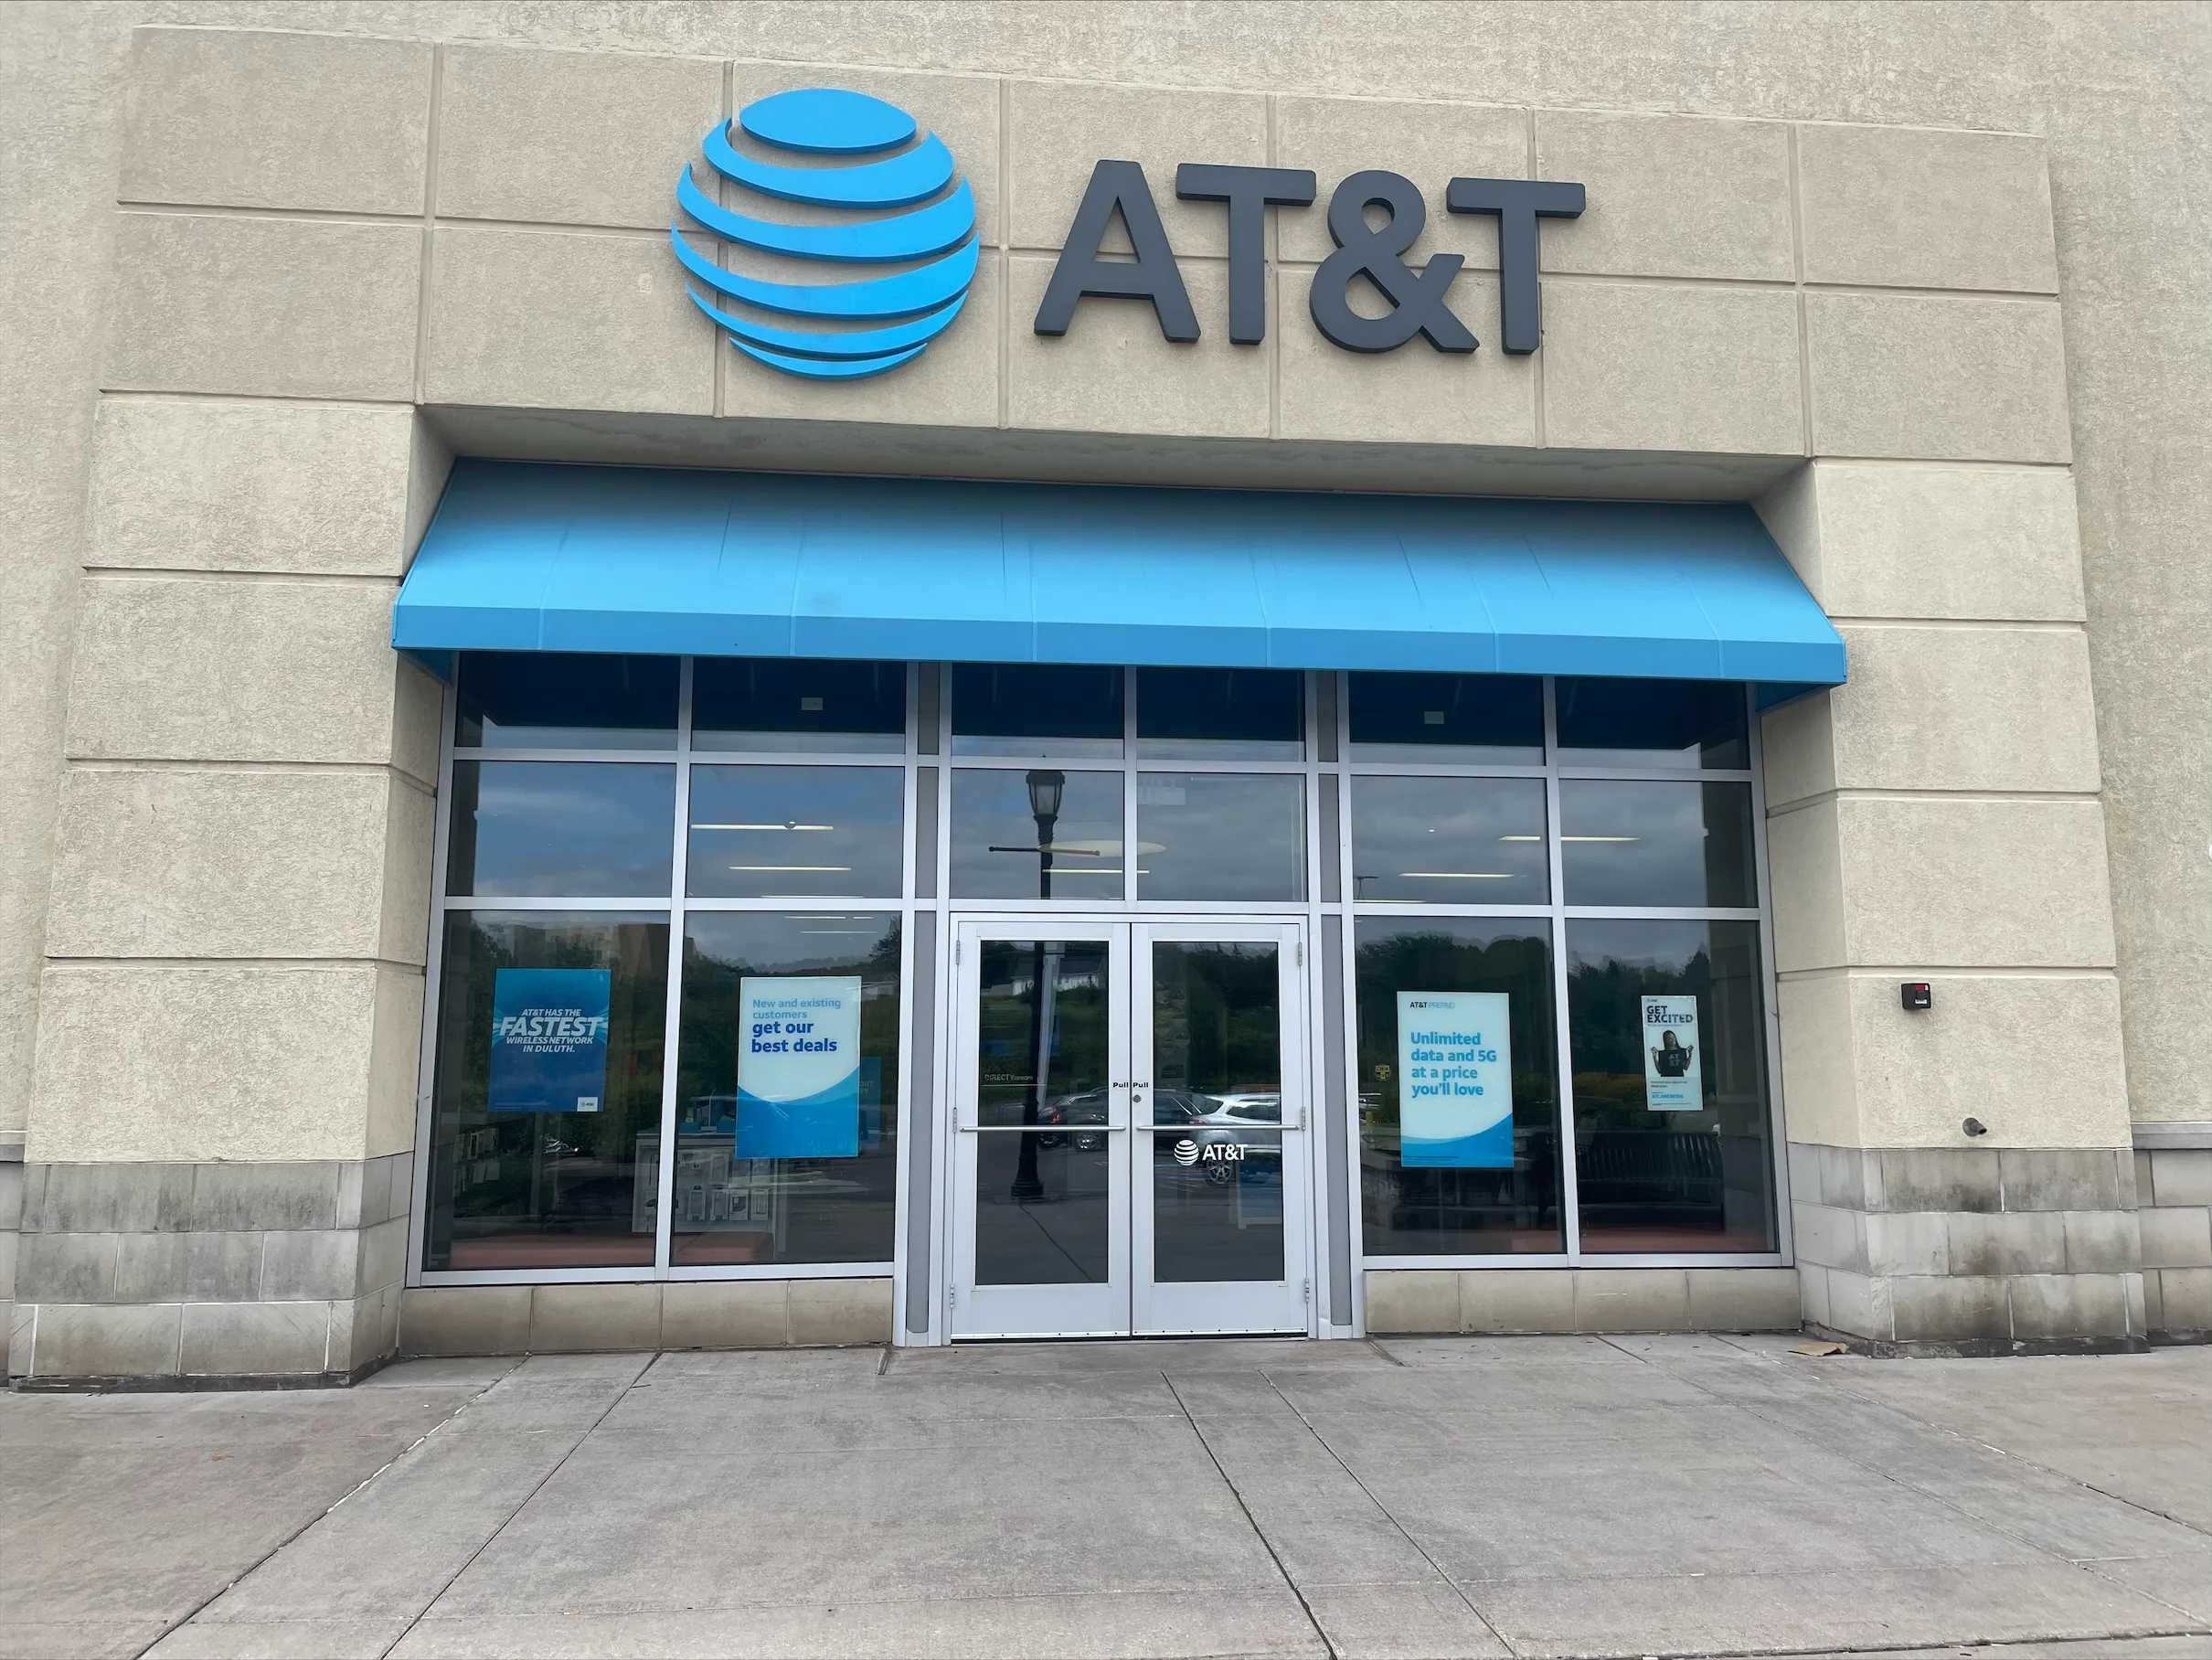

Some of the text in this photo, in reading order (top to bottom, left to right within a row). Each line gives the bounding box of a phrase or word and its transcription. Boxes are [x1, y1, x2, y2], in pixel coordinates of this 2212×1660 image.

[1034, 159, 1586, 355] AT&T
[752, 998, 841, 1009] New and existing
[1646, 1006, 1667, 1015] GET
[521, 1008, 581, 1016] AT&T HAS THE
[752, 1010, 808, 1019] customers
[1647, 1014, 1693, 1023] EXCITED
[499, 1016, 604, 1037] FASTEST
[752, 1021, 814, 1038] get our
[506, 1037, 594, 1045] WIRELESS NETWORK
[1410, 1031, 1482, 1045] Unlimited
[522, 1045, 576, 1053] IN DULUTH.
[751, 1038, 837, 1053] best deals
[1410, 1048, 1497, 1062] data and 5G
[1411, 1066, 1478, 1081] at a price
[1411, 1082, 1484, 1099] you'll love
[1202, 1144, 1249, 1161] AT&T
